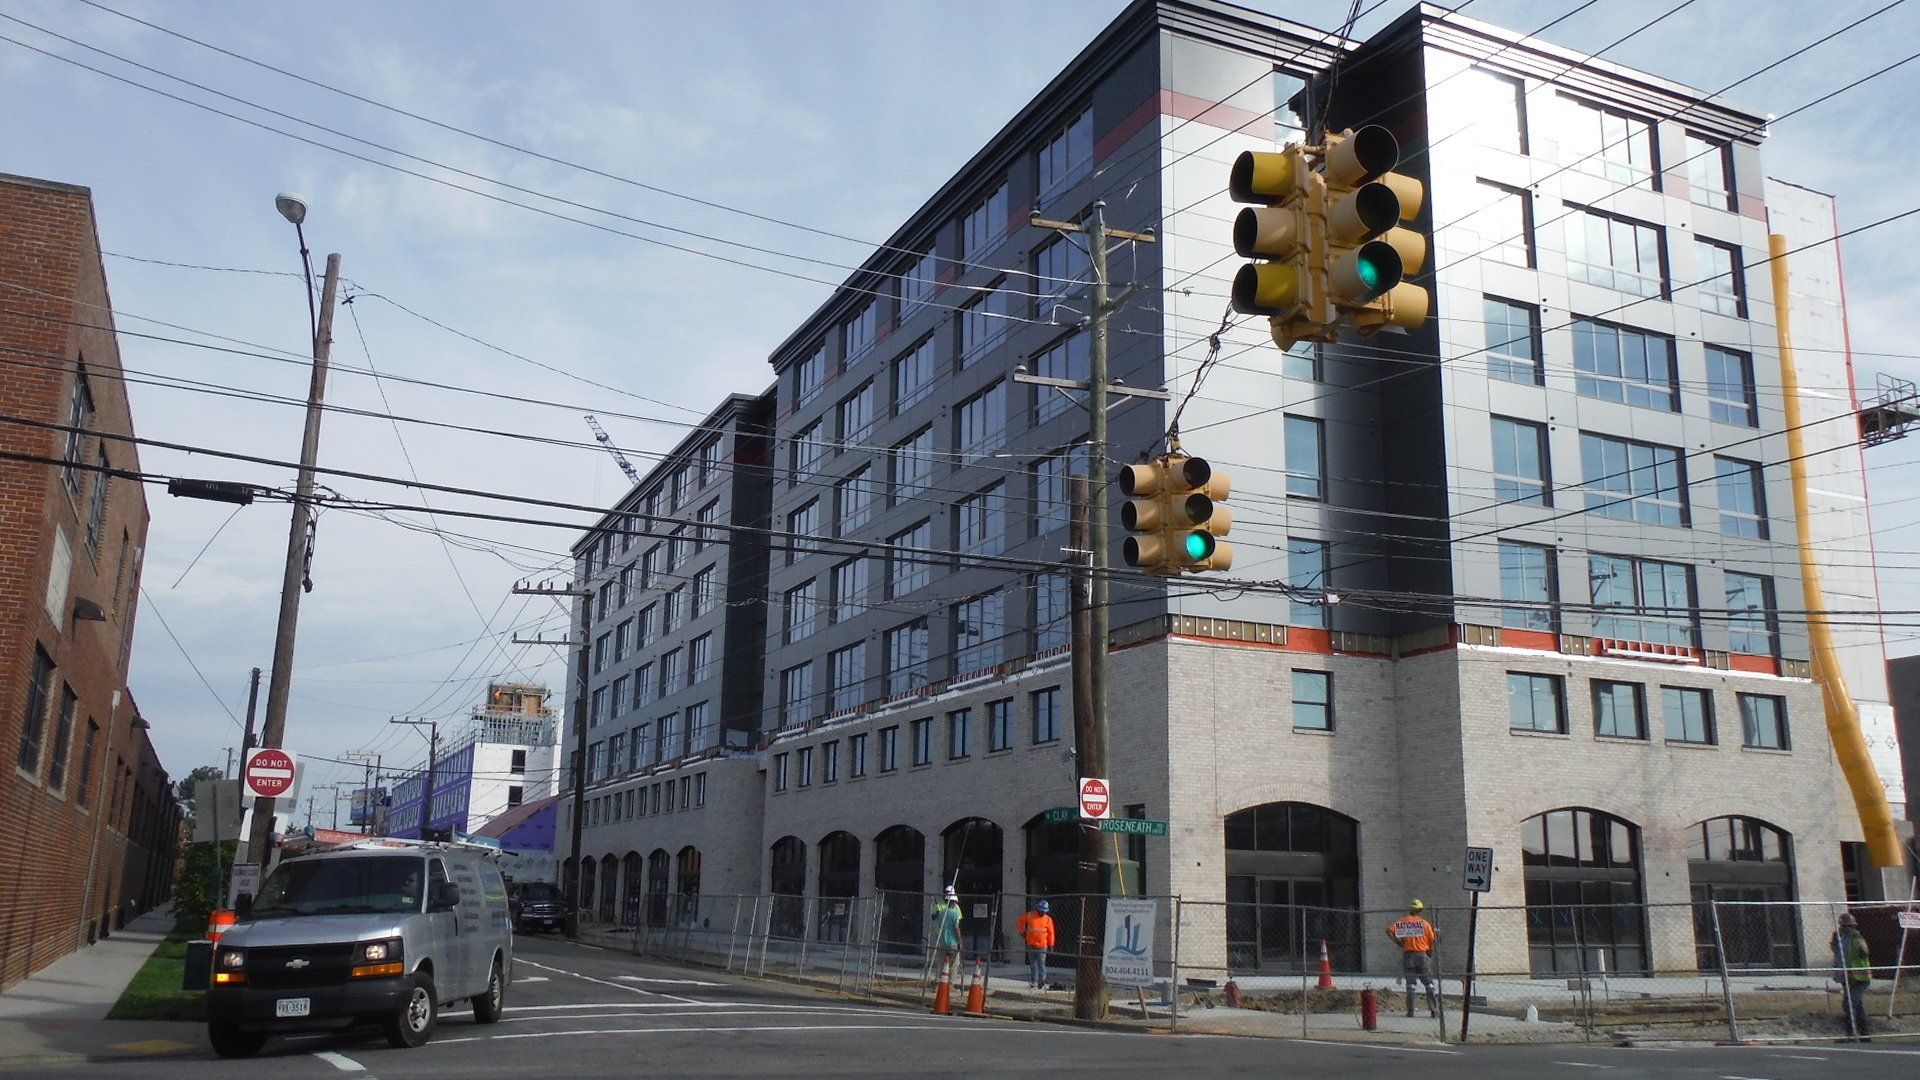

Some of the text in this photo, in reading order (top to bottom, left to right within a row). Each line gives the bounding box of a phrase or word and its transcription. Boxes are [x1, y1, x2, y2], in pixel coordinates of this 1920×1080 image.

[256, 779, 282, 787] ENTER
[1087, 803, 1103, 811] ENTER
[1052, 810, 1069, 821] CLAY
[1104, 819, 1152, 833] ROSENEATH
[1468, 850, 1488, 863] ONE
[1468, 863, 1487, 874] WAY
[1395, 921, 1423, 929] NATIONAL
